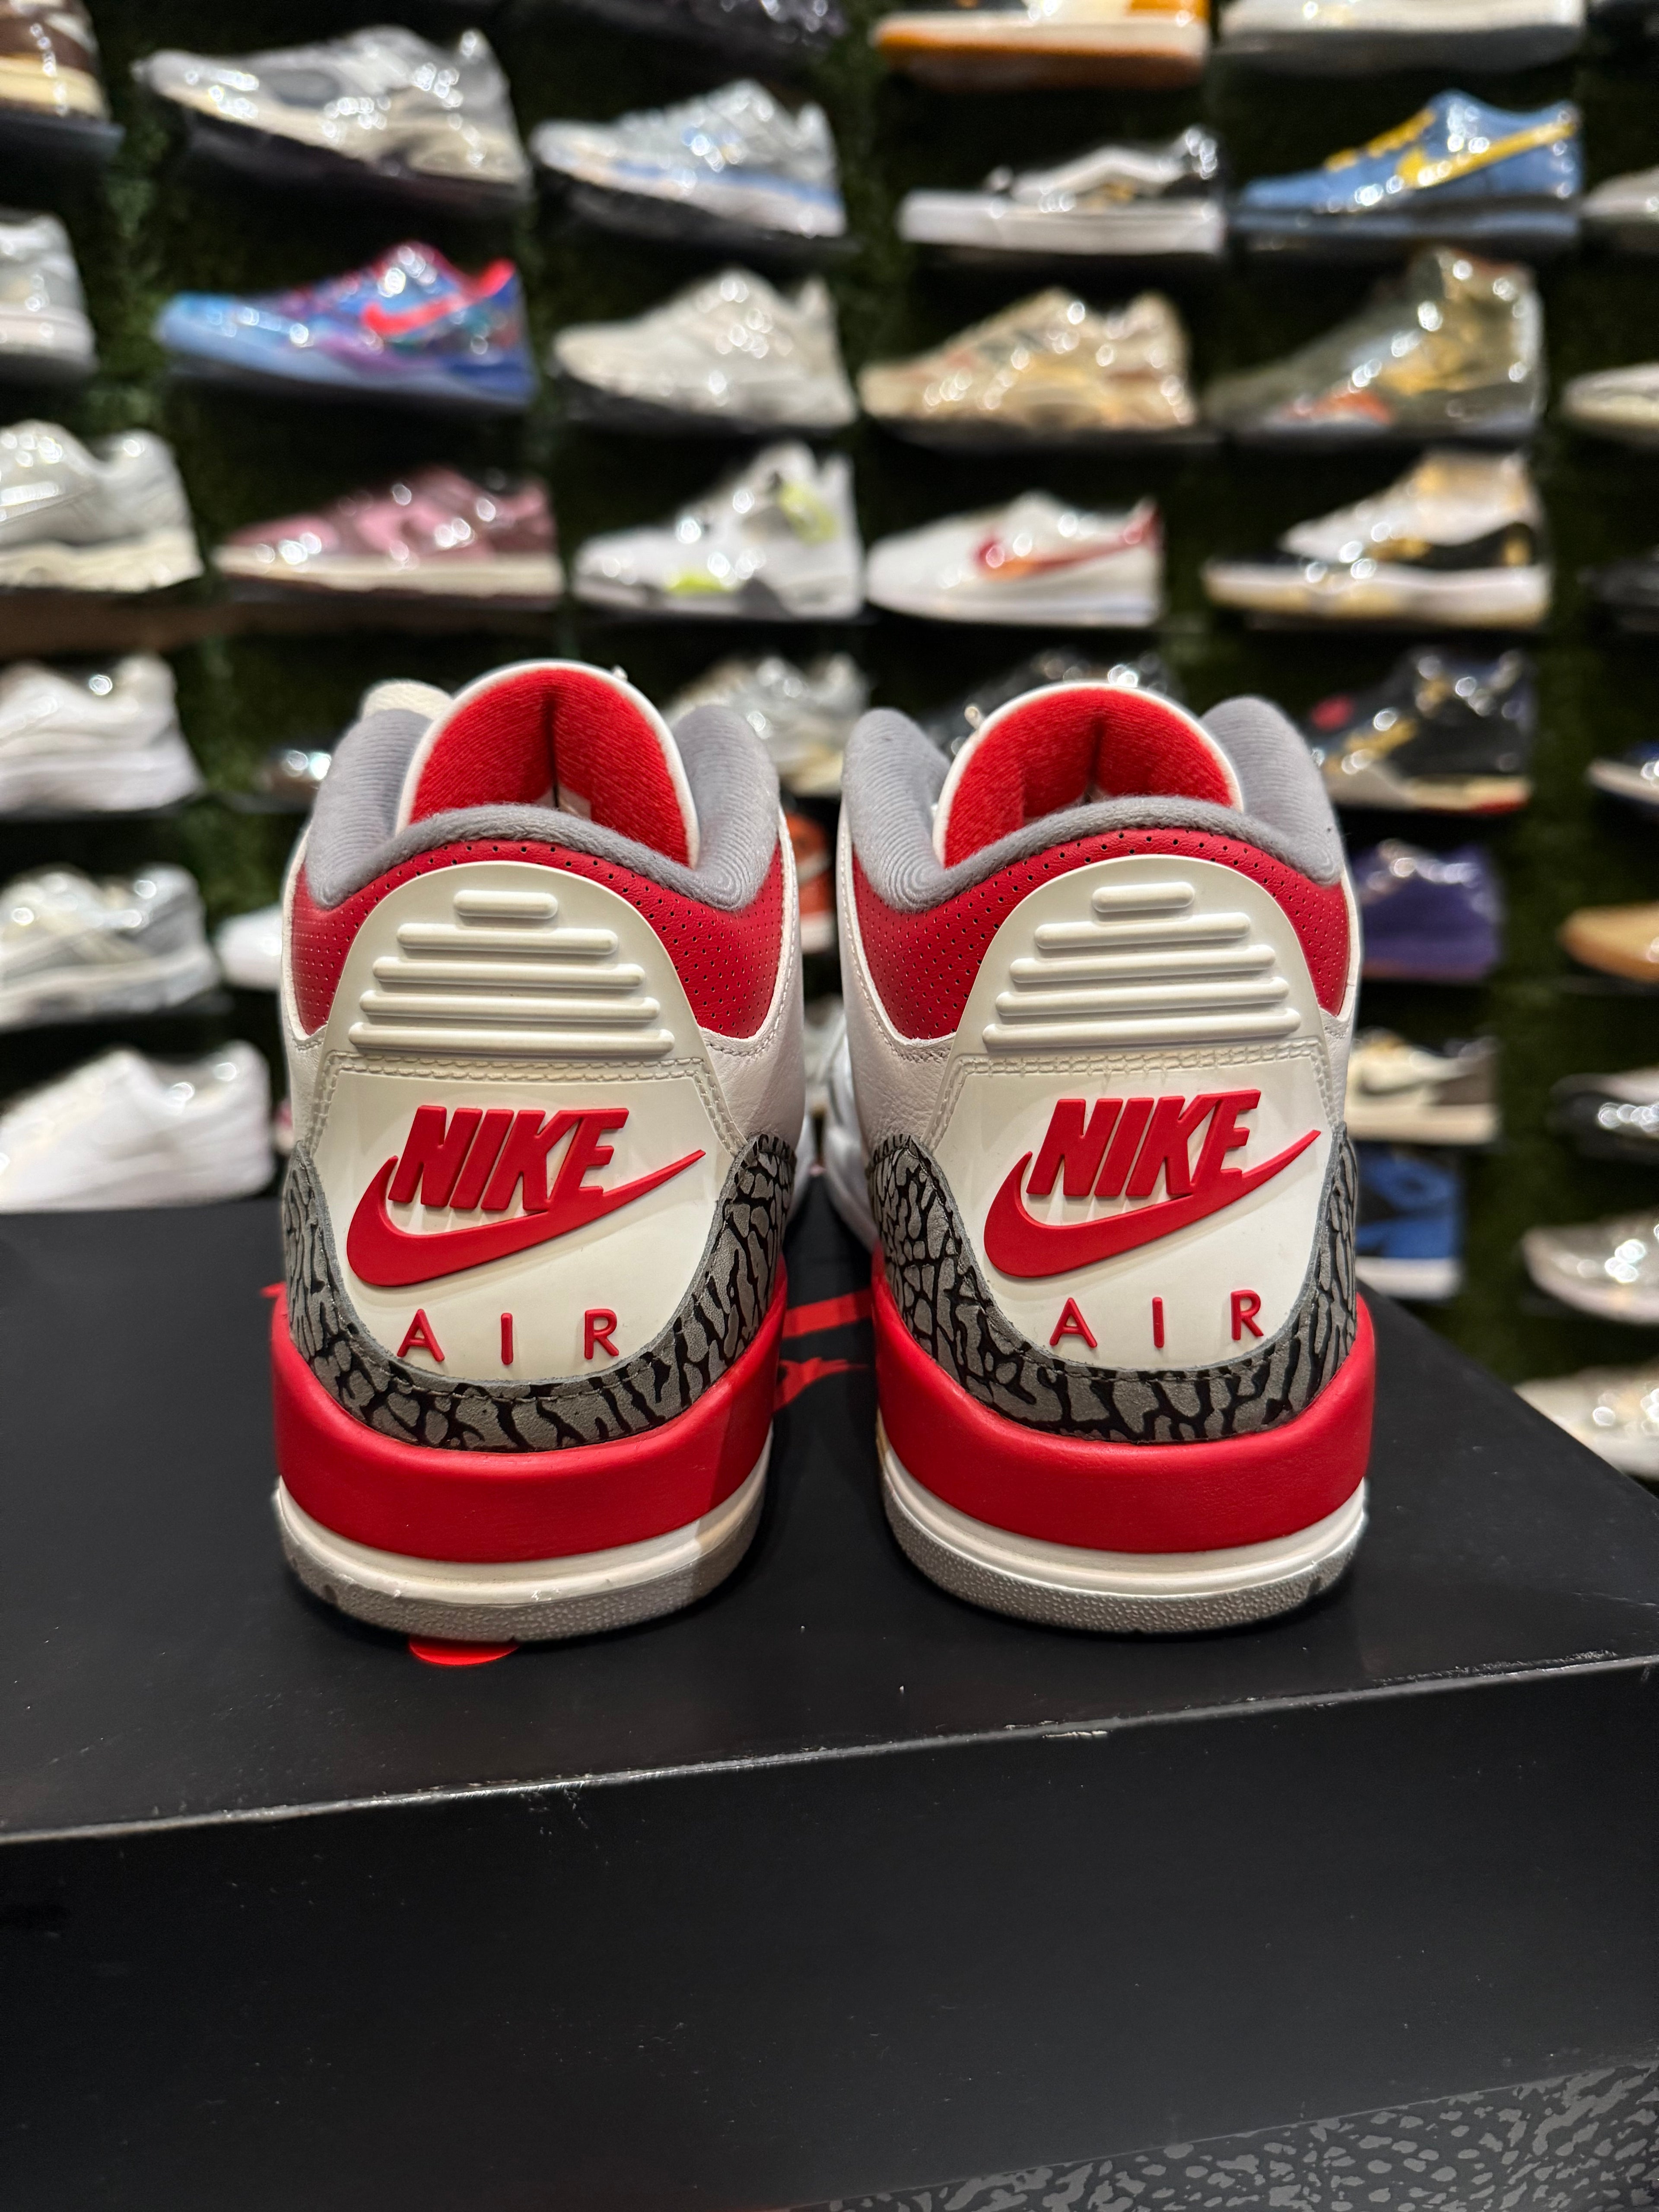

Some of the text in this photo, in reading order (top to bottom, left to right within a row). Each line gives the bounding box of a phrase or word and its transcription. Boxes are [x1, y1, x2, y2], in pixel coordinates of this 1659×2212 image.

[388, 1105, 629, 1212] NIKE
[1026, 1089, 1261, 1199] NIKE
[397, 1308, 620, 1365] AIR
[1049, 1290, 1264, 1349] AIR
